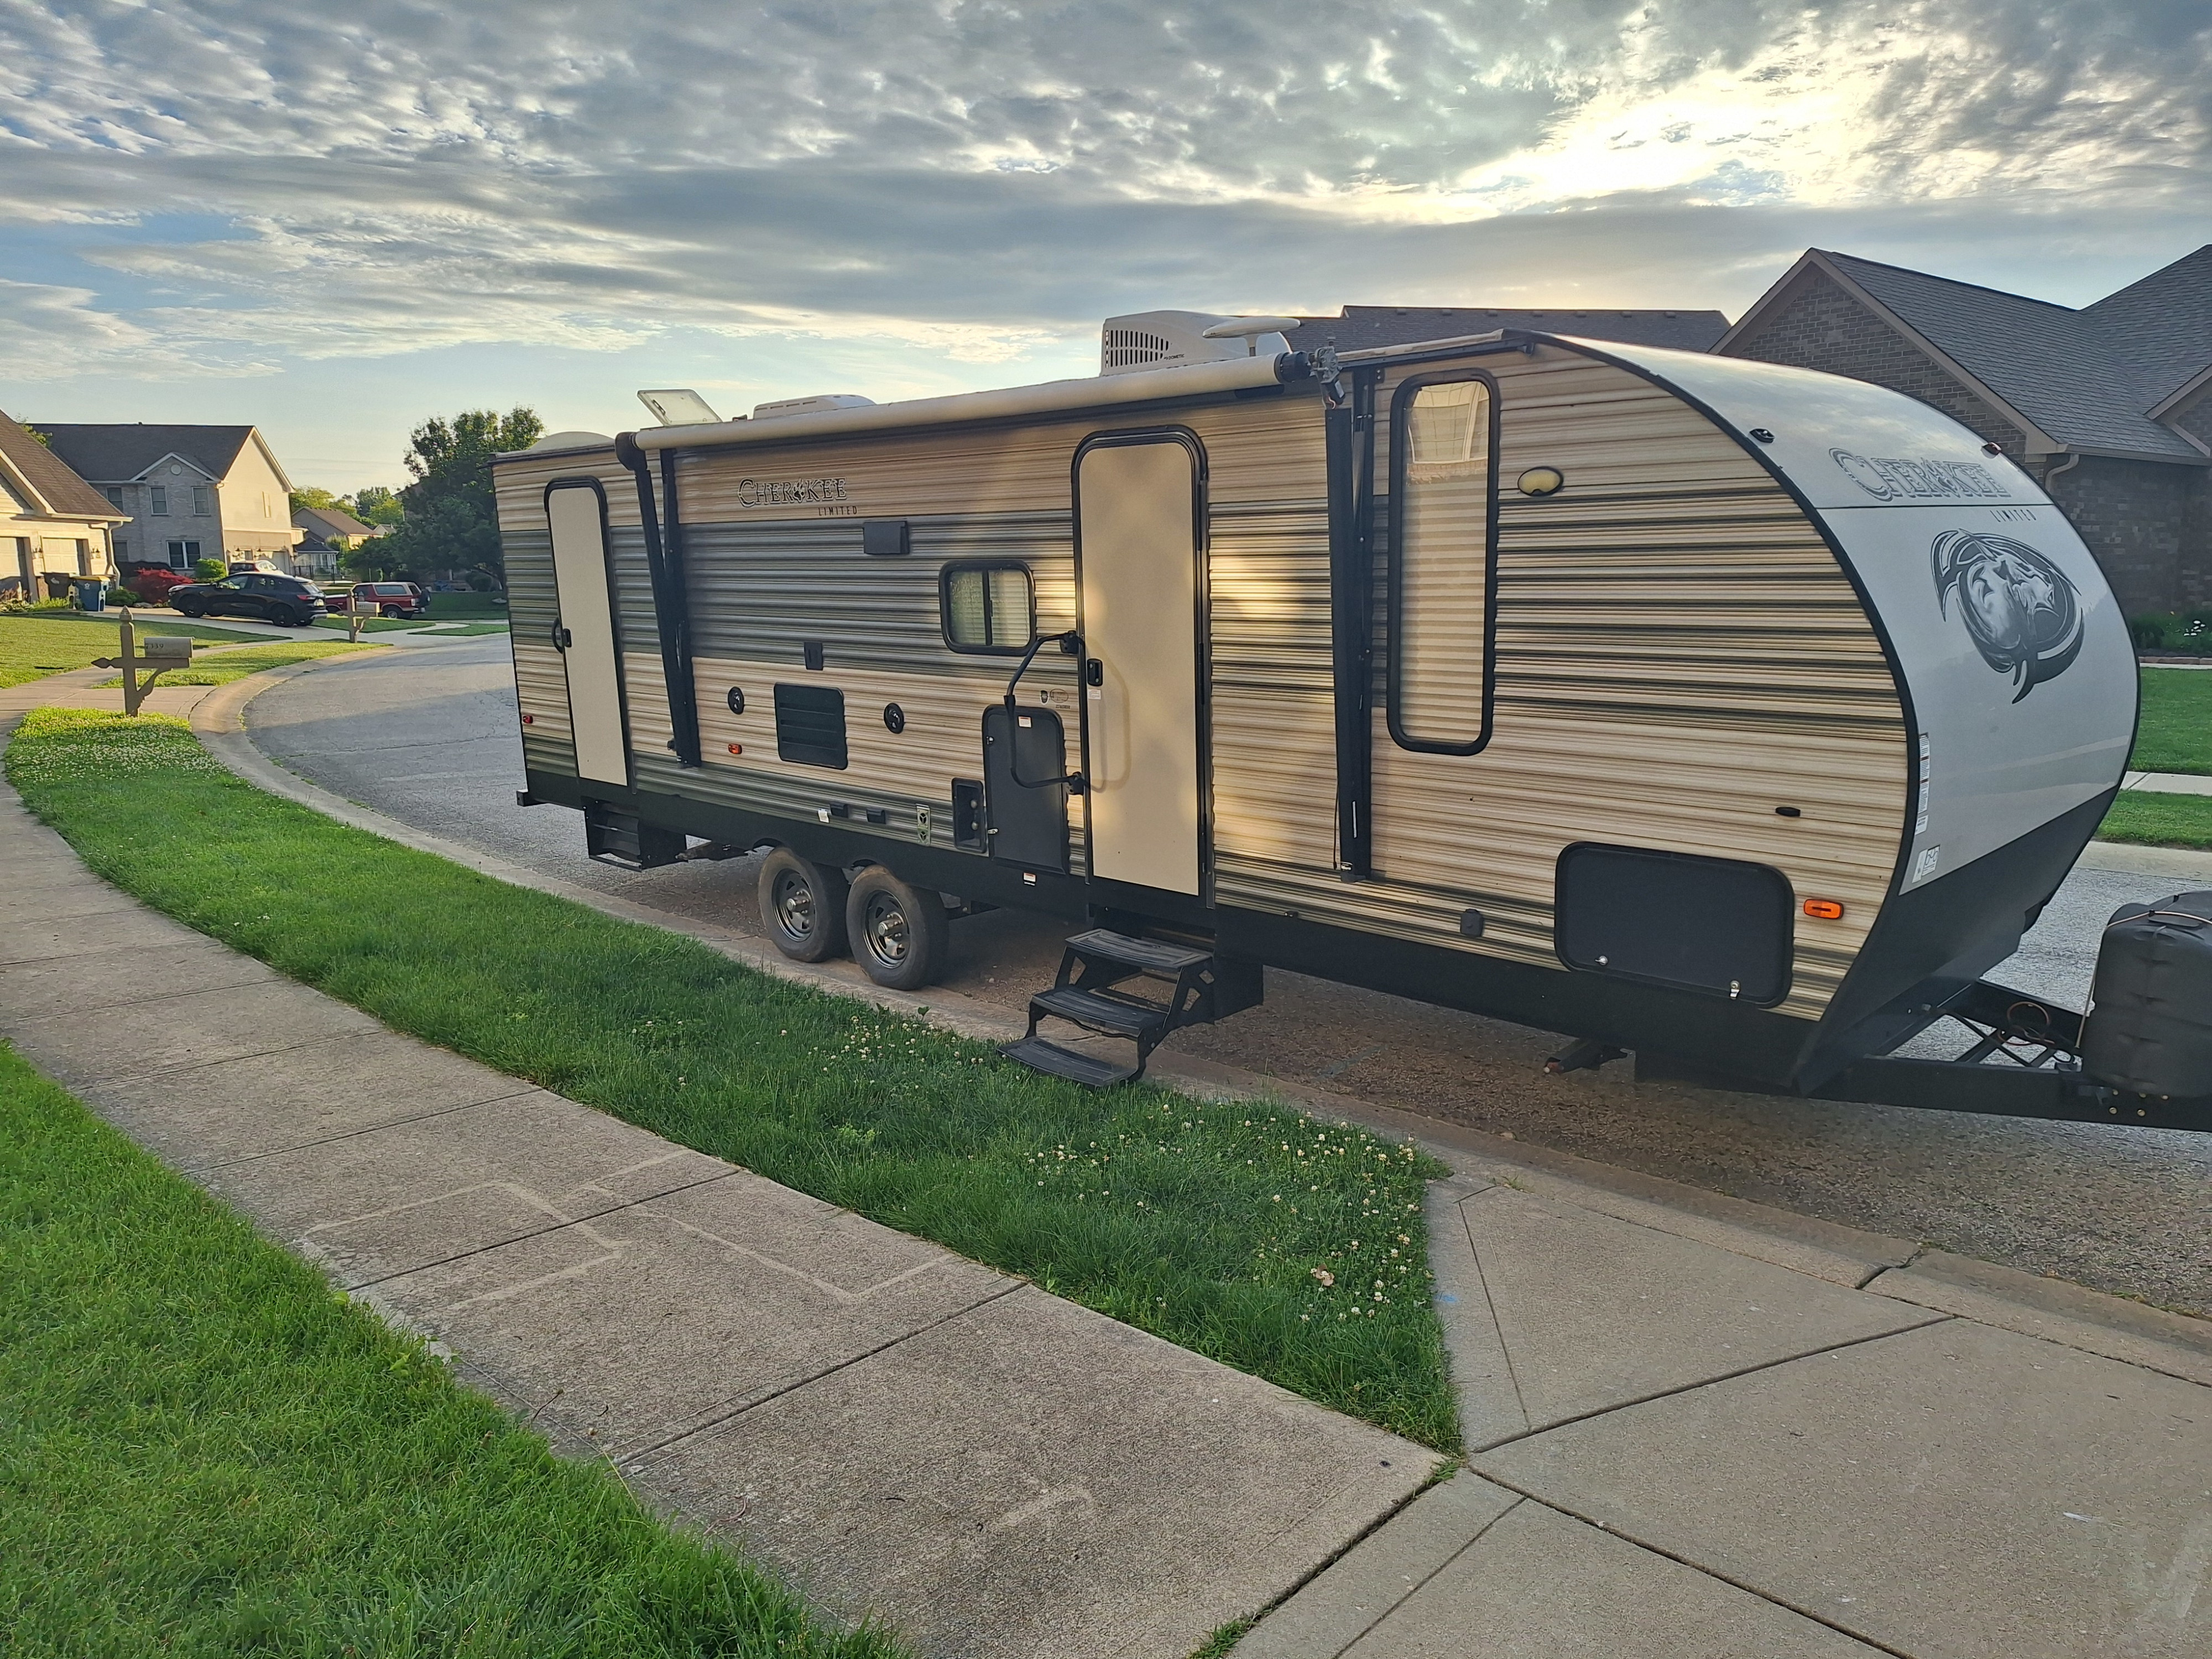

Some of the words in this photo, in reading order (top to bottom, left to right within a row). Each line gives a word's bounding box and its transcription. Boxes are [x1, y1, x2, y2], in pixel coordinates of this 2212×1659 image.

[1828, 447, 2012, 502] CHEROKEE
[737, 477, 847, 508] CHEROKEE
[818, 505, 858, 517] LIMITED
[1989, 509, 2037, 523] LIMITED
